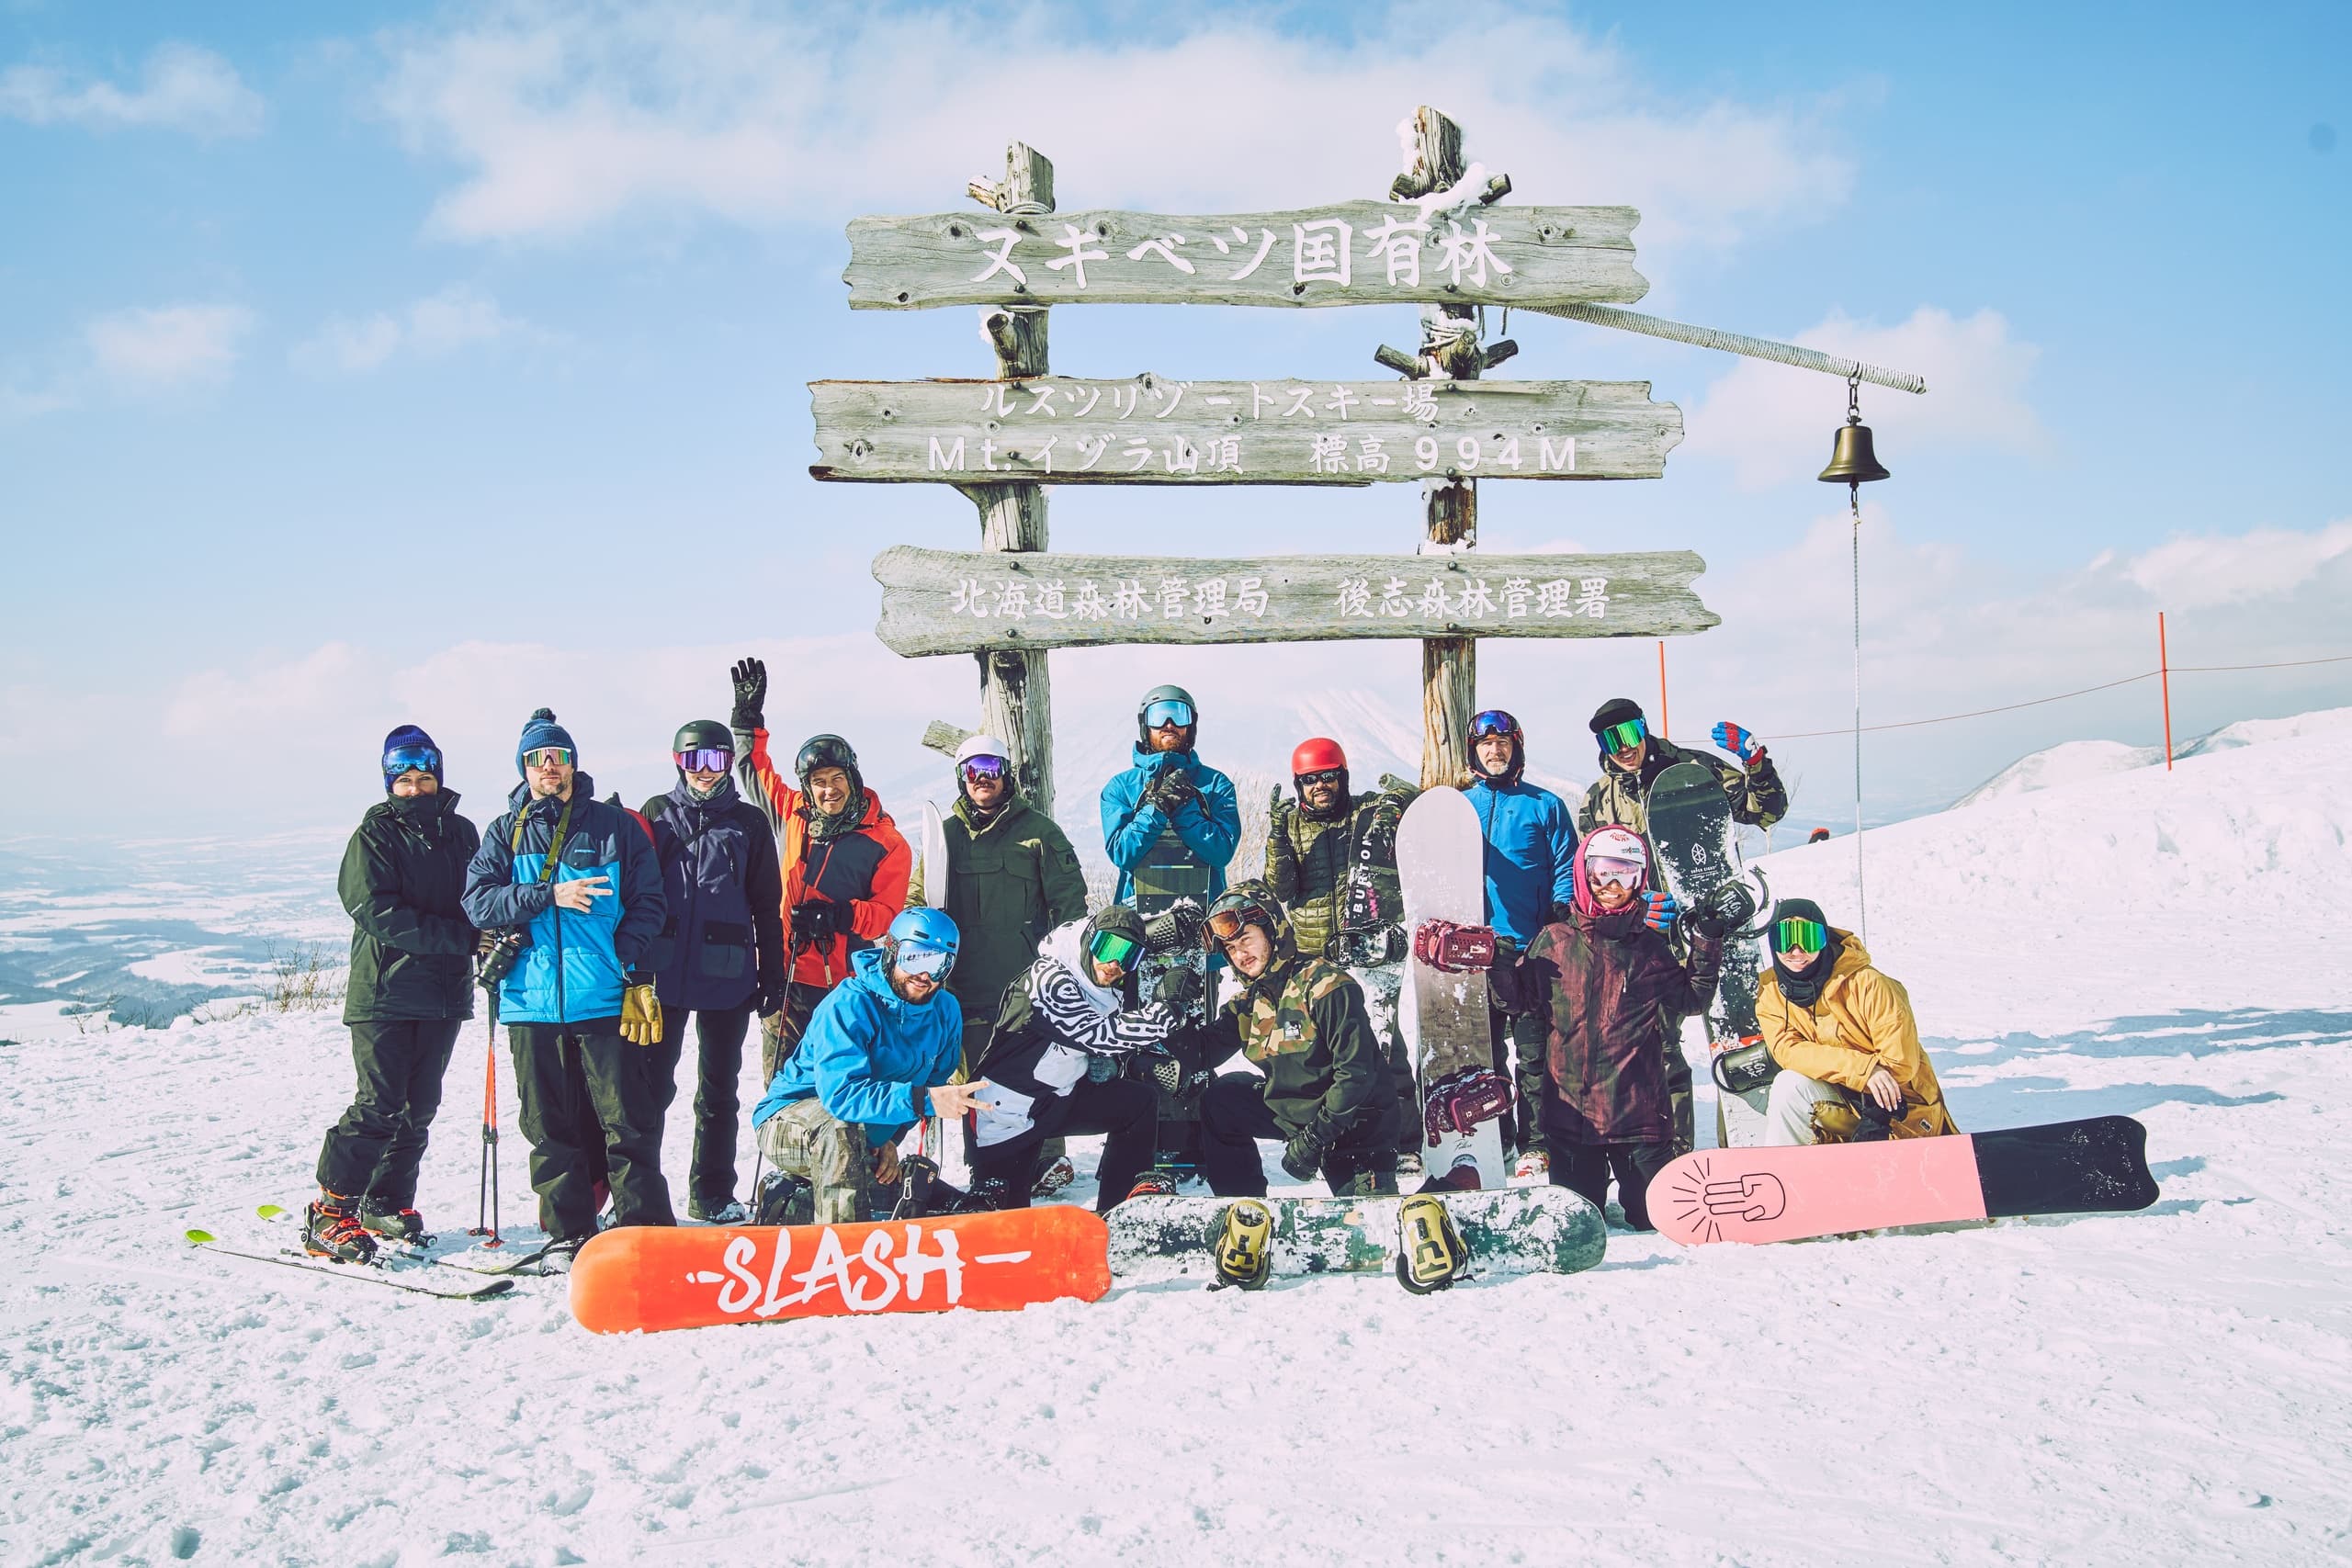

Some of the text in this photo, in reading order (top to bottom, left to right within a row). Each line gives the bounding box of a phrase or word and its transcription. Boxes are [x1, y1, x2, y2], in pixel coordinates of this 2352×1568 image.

[970, 214, 1512, 288] ヌキベツ国有林
[980, 381, 1440, 422] ルスツリゾートスキー場
[950, 576, 1611, 621] 北海道森林管理局 後志森林管理署
